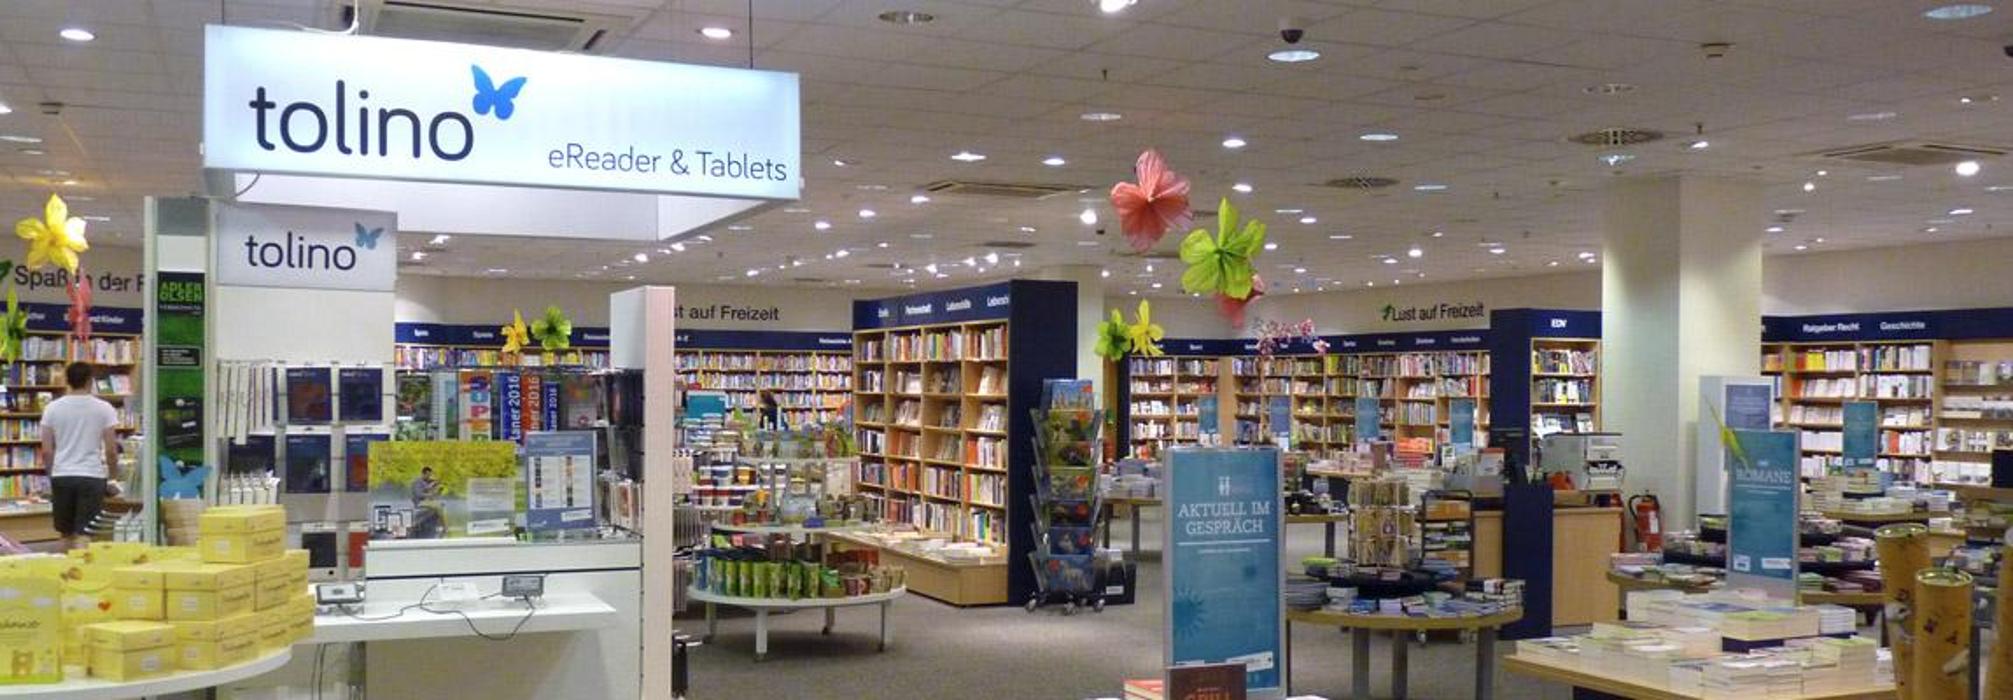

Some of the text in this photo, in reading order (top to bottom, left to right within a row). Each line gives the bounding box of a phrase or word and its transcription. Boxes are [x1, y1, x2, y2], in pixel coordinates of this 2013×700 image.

[249, 79, 475, 162] tolino
[548, 142, 788, 182] eReader & Tablets
[245, 231, 357, 271] tolino
[99, 272, 131, 291] der
[689, 306, 716, 320] auf
[721, 306, 780, 321] Freizeit
[1392, 301, 1484, 321] Lust auf Freizeit
[1736, 468, 1793, 484] ROMANE
[1177, 501, 1270, 518] AKTUELL IM
[1185, 516, 1264, 535] GESPRÄCH
